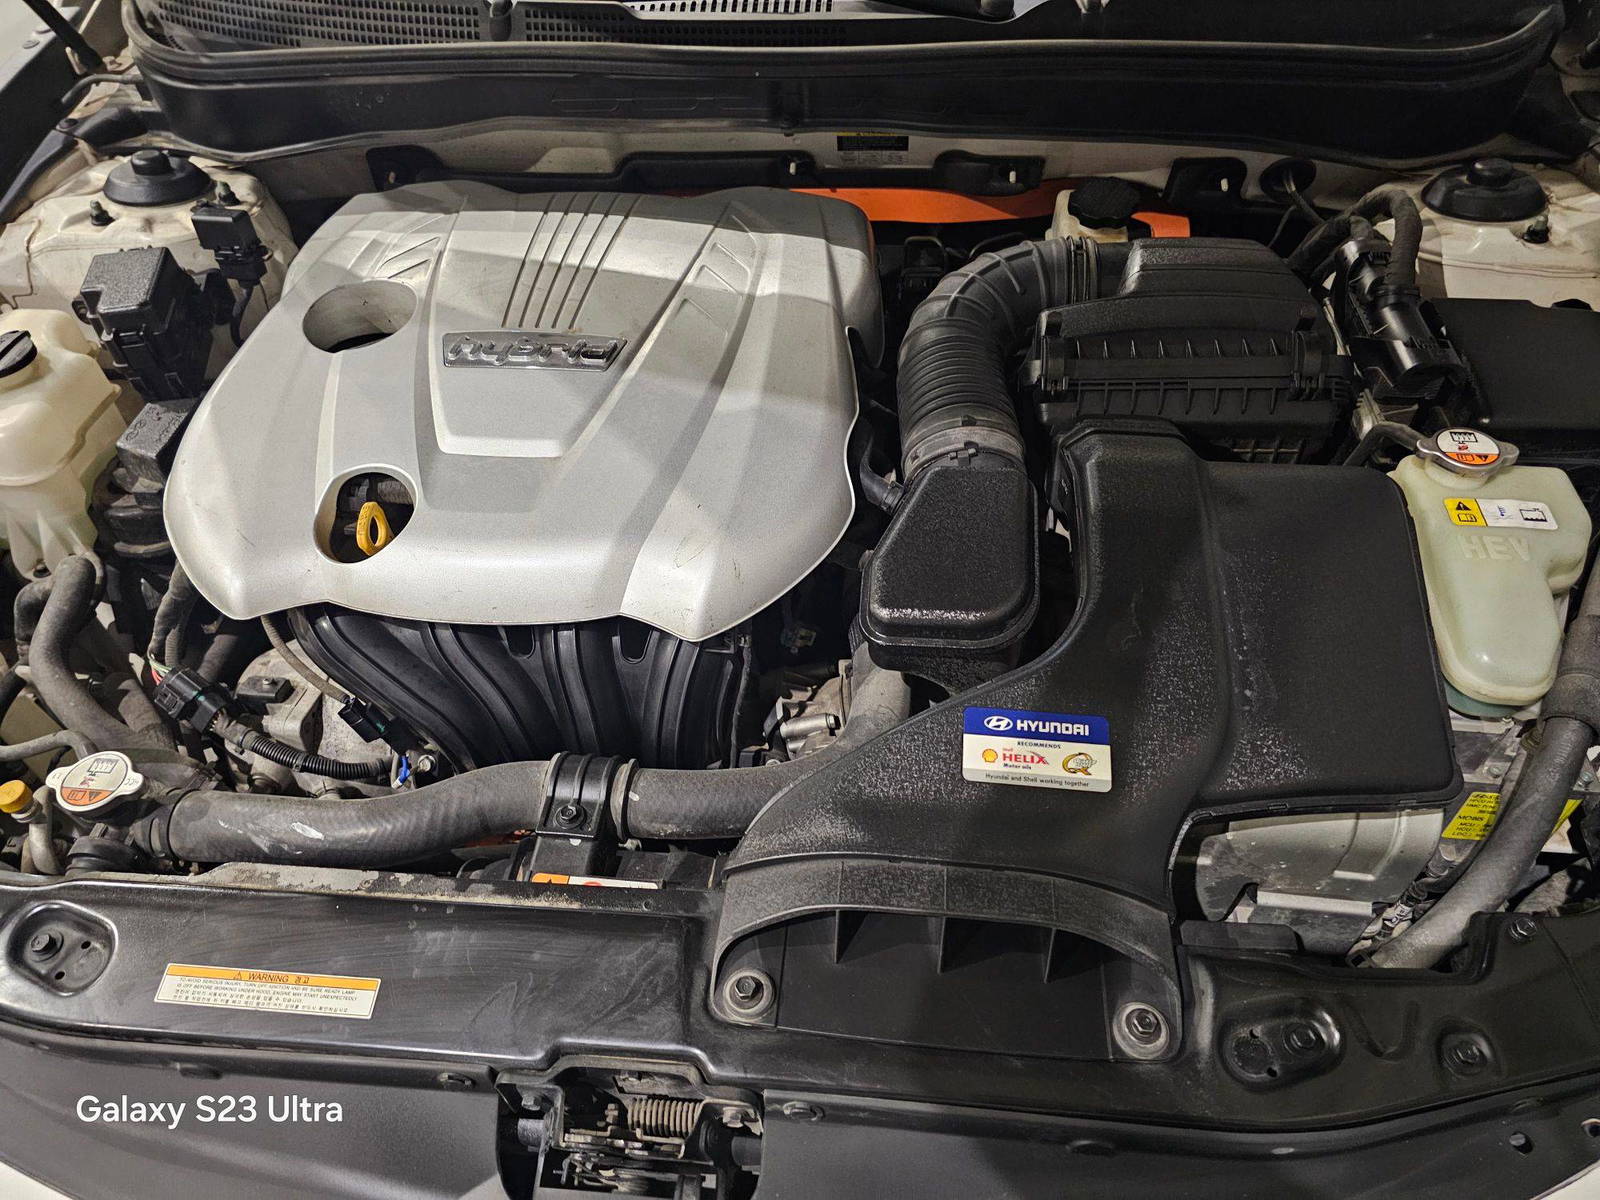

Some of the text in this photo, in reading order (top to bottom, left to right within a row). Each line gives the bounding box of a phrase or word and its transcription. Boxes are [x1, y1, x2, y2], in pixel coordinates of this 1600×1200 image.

[1460, 535, 1531, 561] HEV
[1016, 719, 1090, 736] HYUNDAI
[1017, 741, 1061, 749] RECOMMENDS
[1003, 752, 1049, 765] HELIX
[985, 773, 1009, 781] Hyundai
[1039, 778, 1063, 786] working
[248, 972, 290, 983] WARNING
